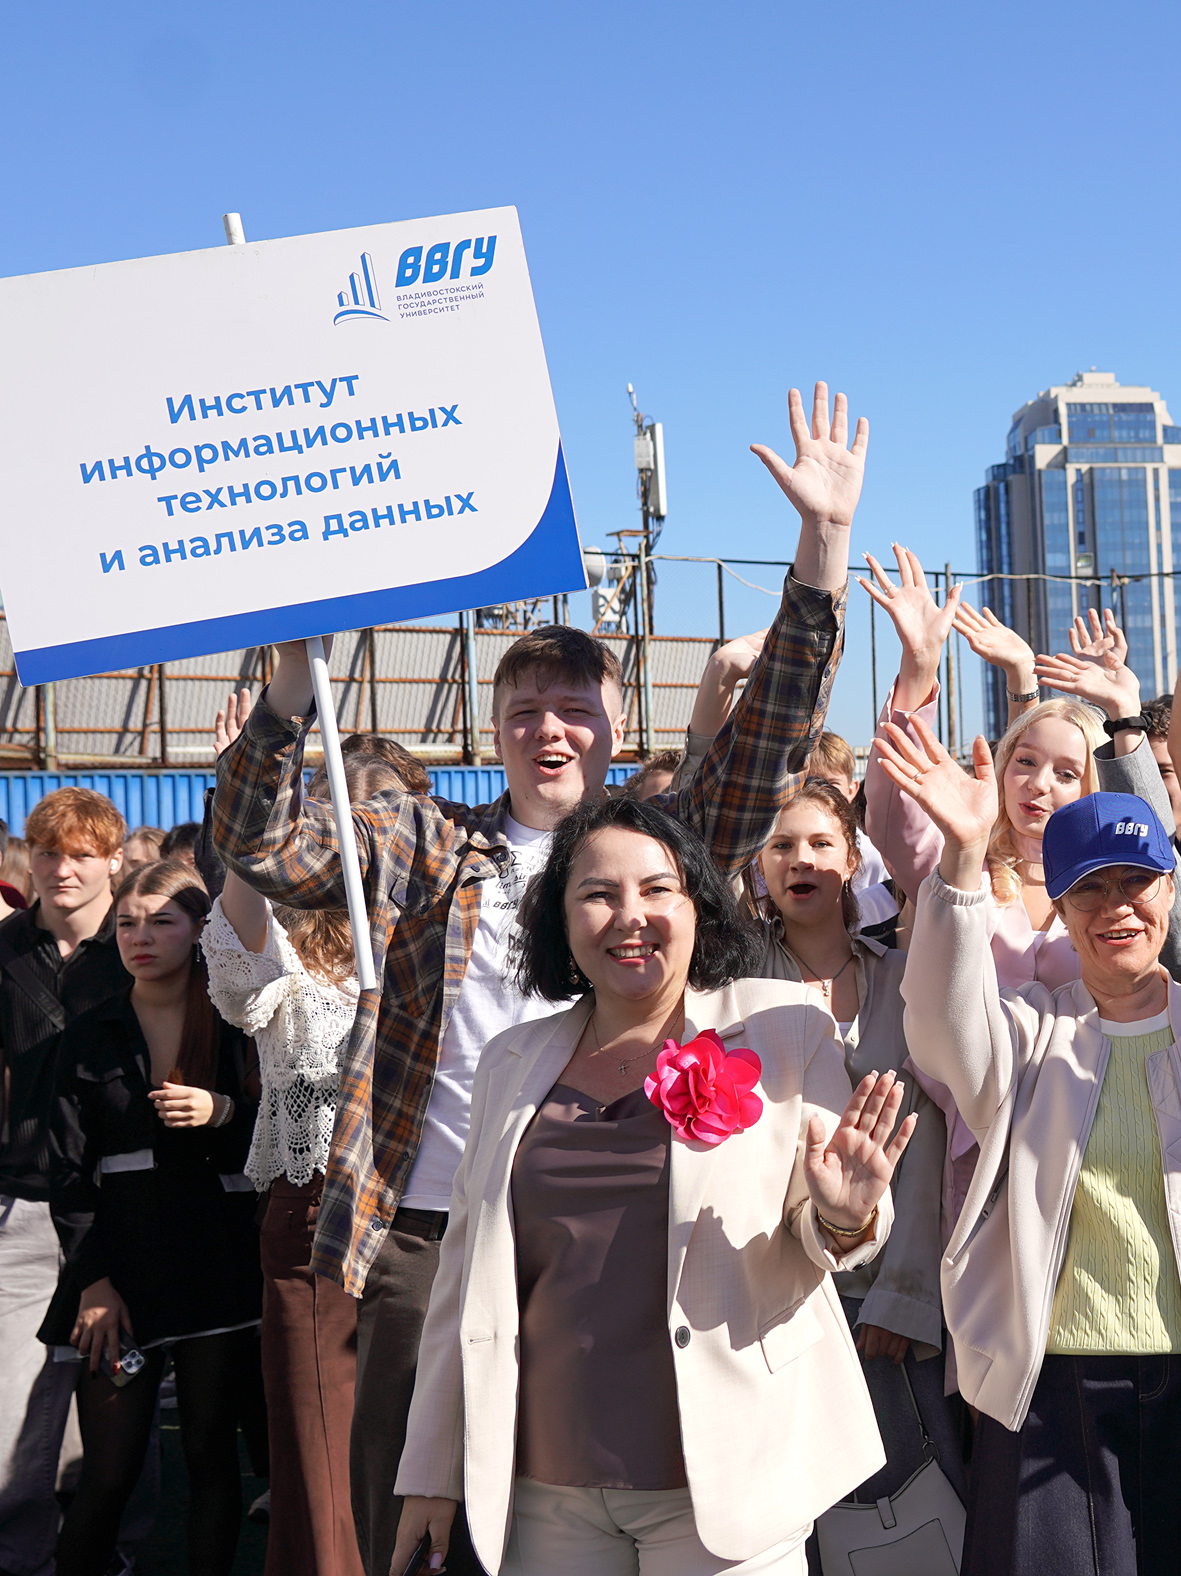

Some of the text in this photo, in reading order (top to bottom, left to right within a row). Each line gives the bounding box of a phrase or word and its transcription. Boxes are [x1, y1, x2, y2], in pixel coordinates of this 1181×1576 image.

[395, 235, 498, 288] ВВГУ
[396, 282, 484, 302] ВЛАДИВОСТОКСКИЙ
[398, 291, 485, 310] ГОСУДАРСТВЕННЫЙ
[400, 304, 461, 319] УНИВЕРСИТЕТ
[166, 374, 360, 424] Институт
[80, 404, 463, 485] информационных
[157, 452, 403, 517] технологий
[100, 491, 479, 574] и анализа данных
[1115, 822, 1149, 837] ВВГУ
